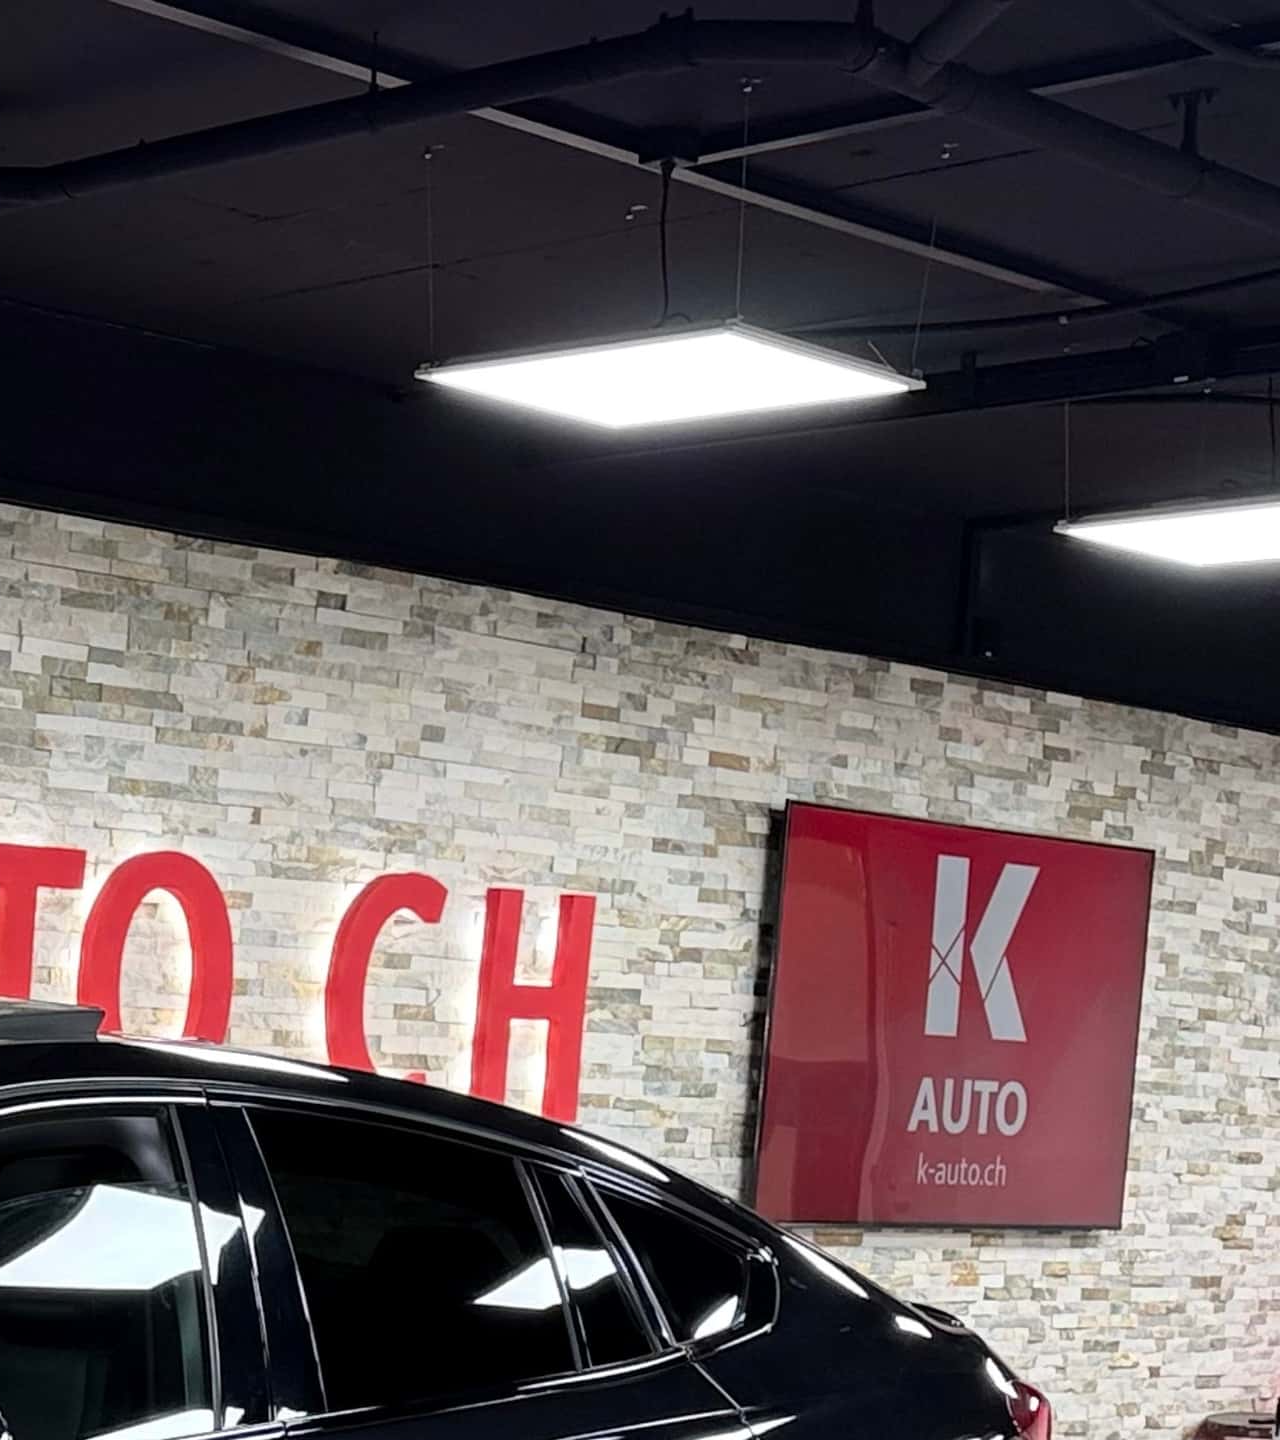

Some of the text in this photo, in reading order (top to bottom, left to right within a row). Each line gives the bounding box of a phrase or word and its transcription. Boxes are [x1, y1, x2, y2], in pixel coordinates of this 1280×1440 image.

[924, 853, 1041, 1043] K
[906, 1076, 1028, 1137] AUTO
[916, 1151, 1007, 1187] k-auto.ch
